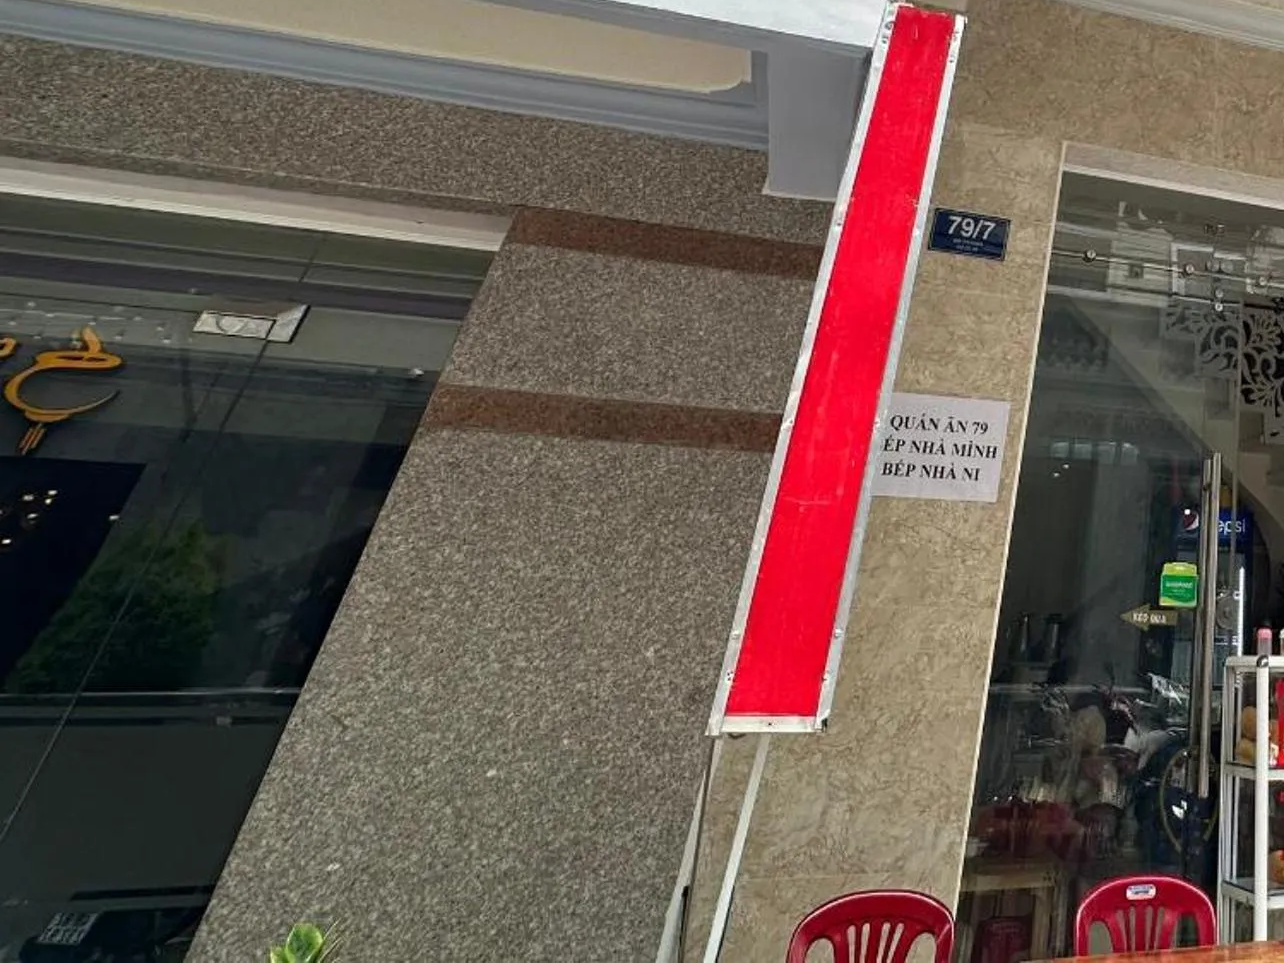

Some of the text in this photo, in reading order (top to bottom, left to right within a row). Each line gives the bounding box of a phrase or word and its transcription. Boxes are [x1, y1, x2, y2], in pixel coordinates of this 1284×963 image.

[948, 215, 996, 240] 79/7
[890, 413, 989, 435] QUÁN ĂN 79
[882, 434, 998, 459] ẾP NHÀ MÌNH
[920, 463, 957, 480] NHÀ
[961, 467, 981, 482] NI
[1217, 517, 1247, 536] epsi
